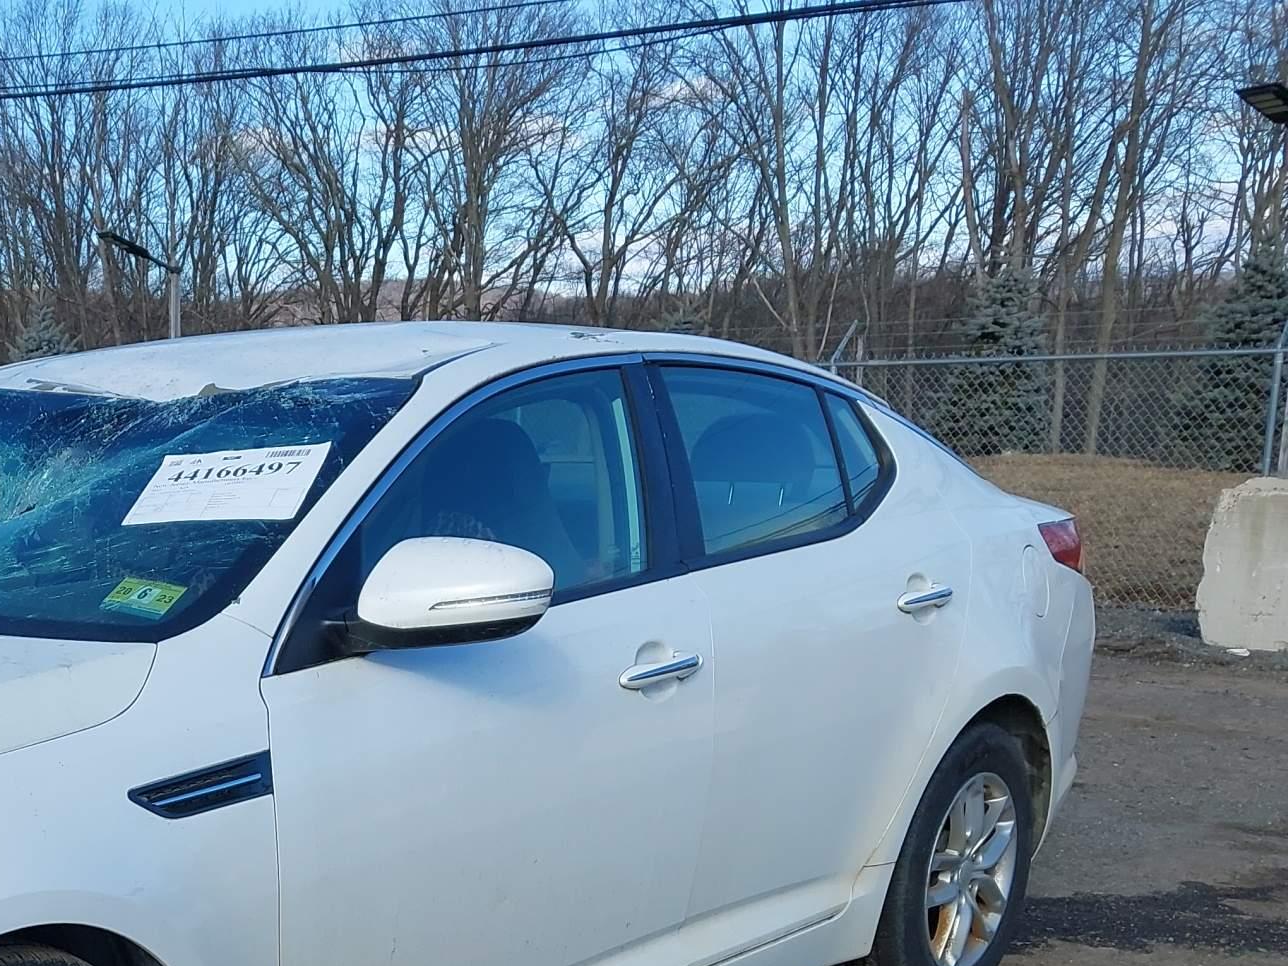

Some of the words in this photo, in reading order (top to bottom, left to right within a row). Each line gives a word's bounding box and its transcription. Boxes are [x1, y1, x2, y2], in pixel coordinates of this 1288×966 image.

[168, 461, 303, 482] 44166497
[115, 586, 133, 596] 20
[136, 587, 153, 600] 6
[155, 594, 175, 604] 23
